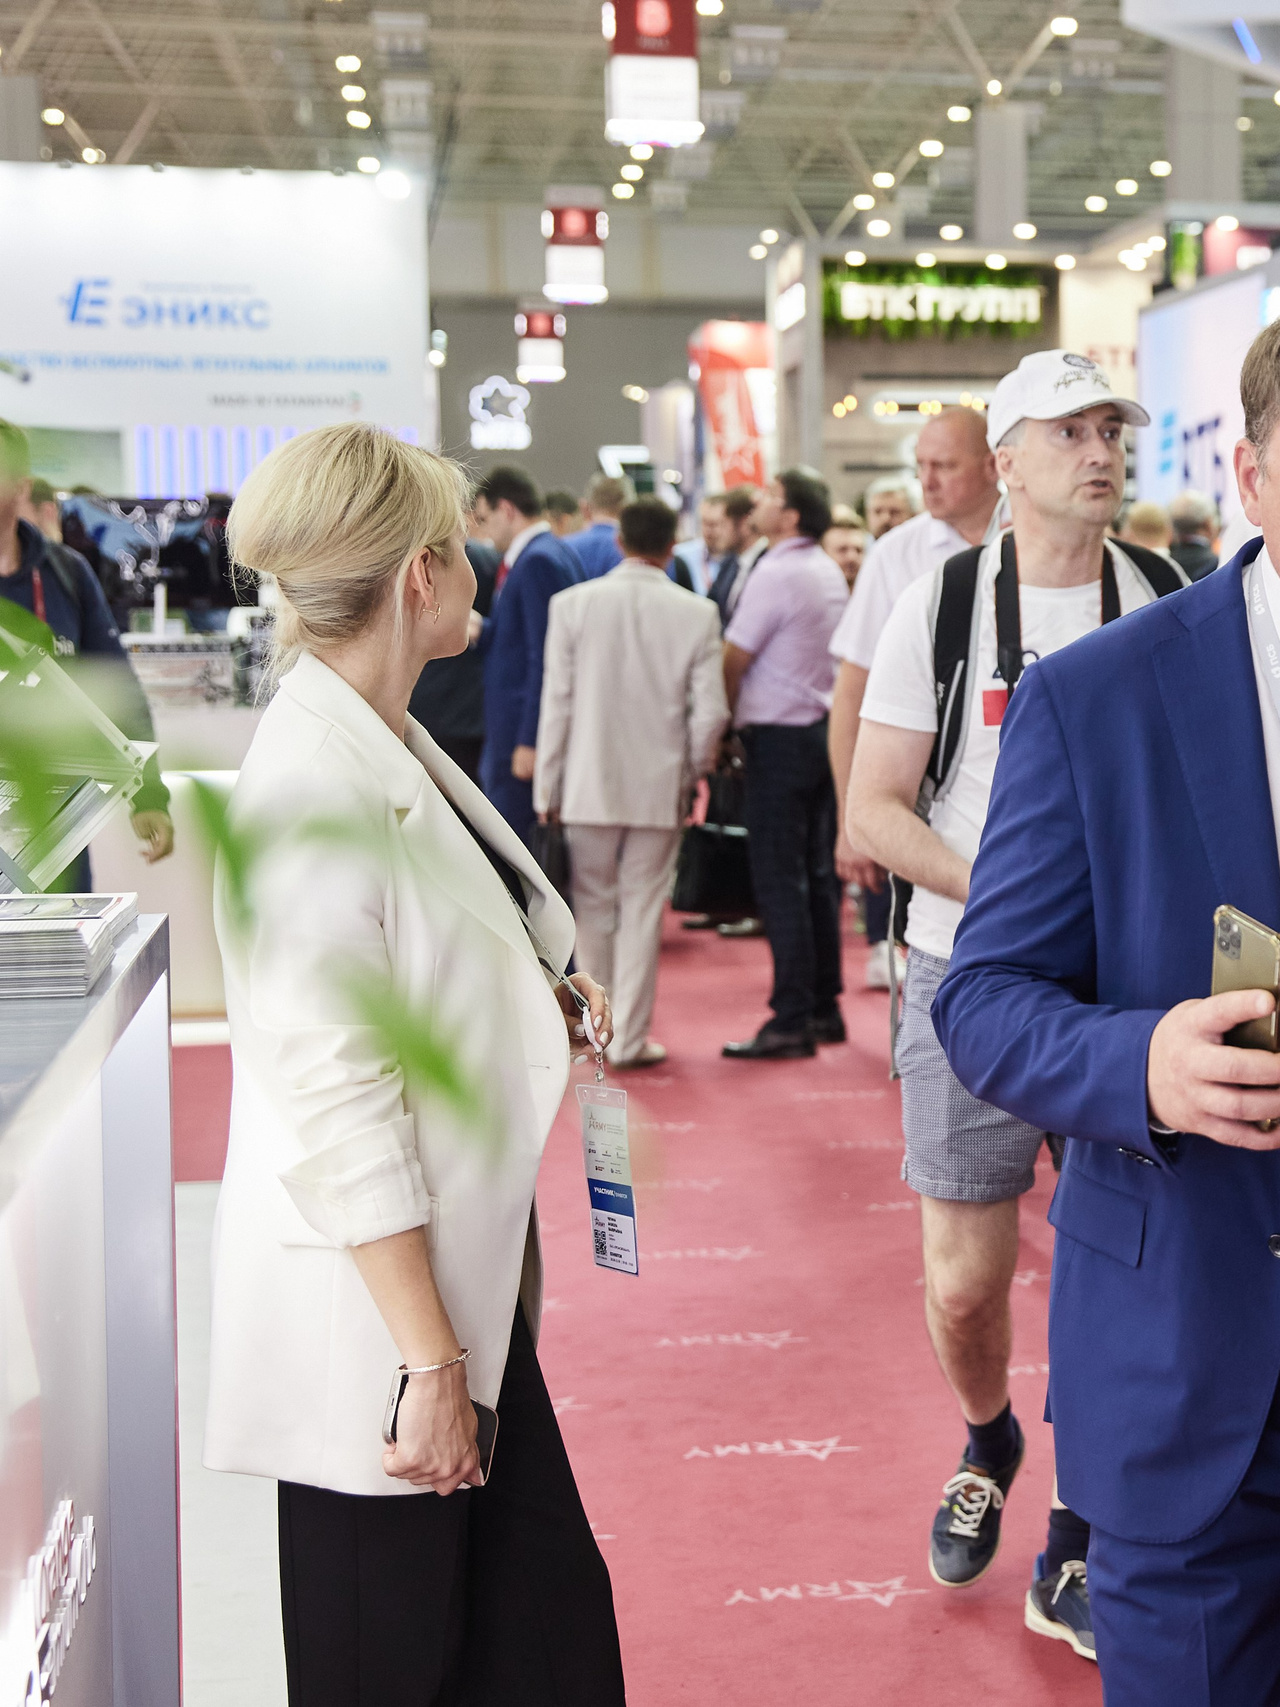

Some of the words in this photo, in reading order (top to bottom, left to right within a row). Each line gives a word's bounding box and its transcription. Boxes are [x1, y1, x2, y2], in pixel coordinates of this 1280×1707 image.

[122, 299, 270, 329] ЭНИКС
[683, 1436, 860, 1461] ARMY
[725, 1575, 931, 1608] ARMY
